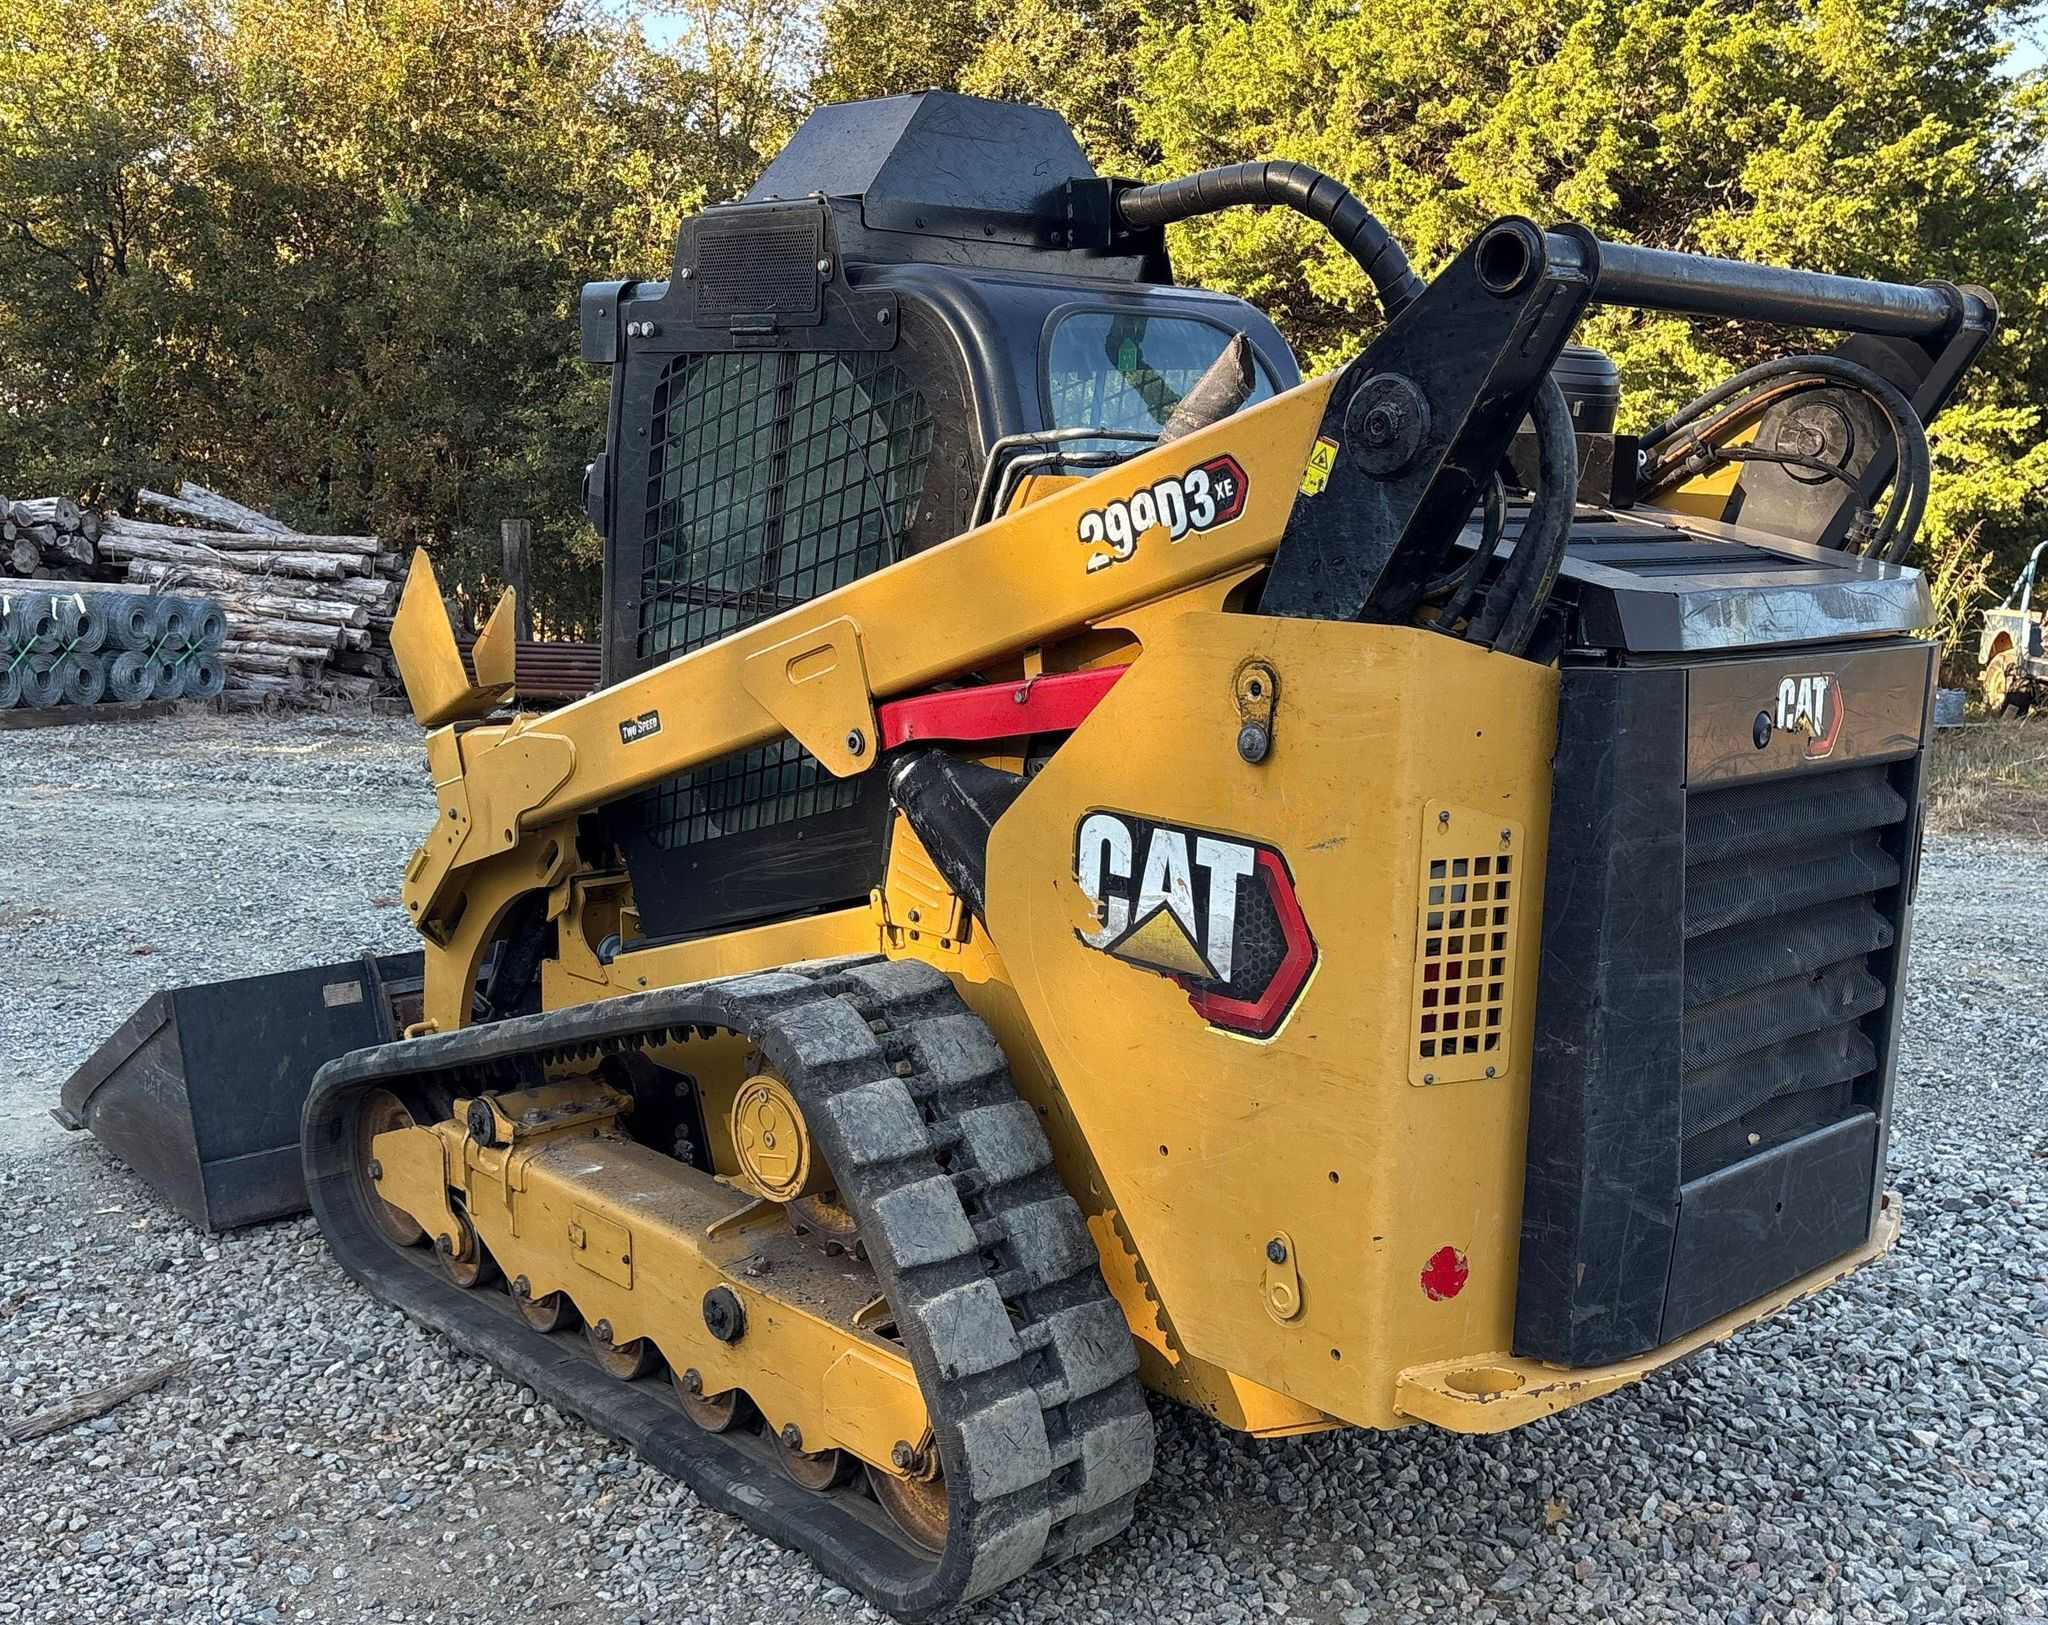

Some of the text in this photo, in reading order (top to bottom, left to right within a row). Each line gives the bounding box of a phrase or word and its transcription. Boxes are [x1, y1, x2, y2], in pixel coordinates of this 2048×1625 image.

[1214, 478, 1234, 501] XE
[1777, 676, 1829, 737] CAT
[1079, 814, 1255, 983] CAT
